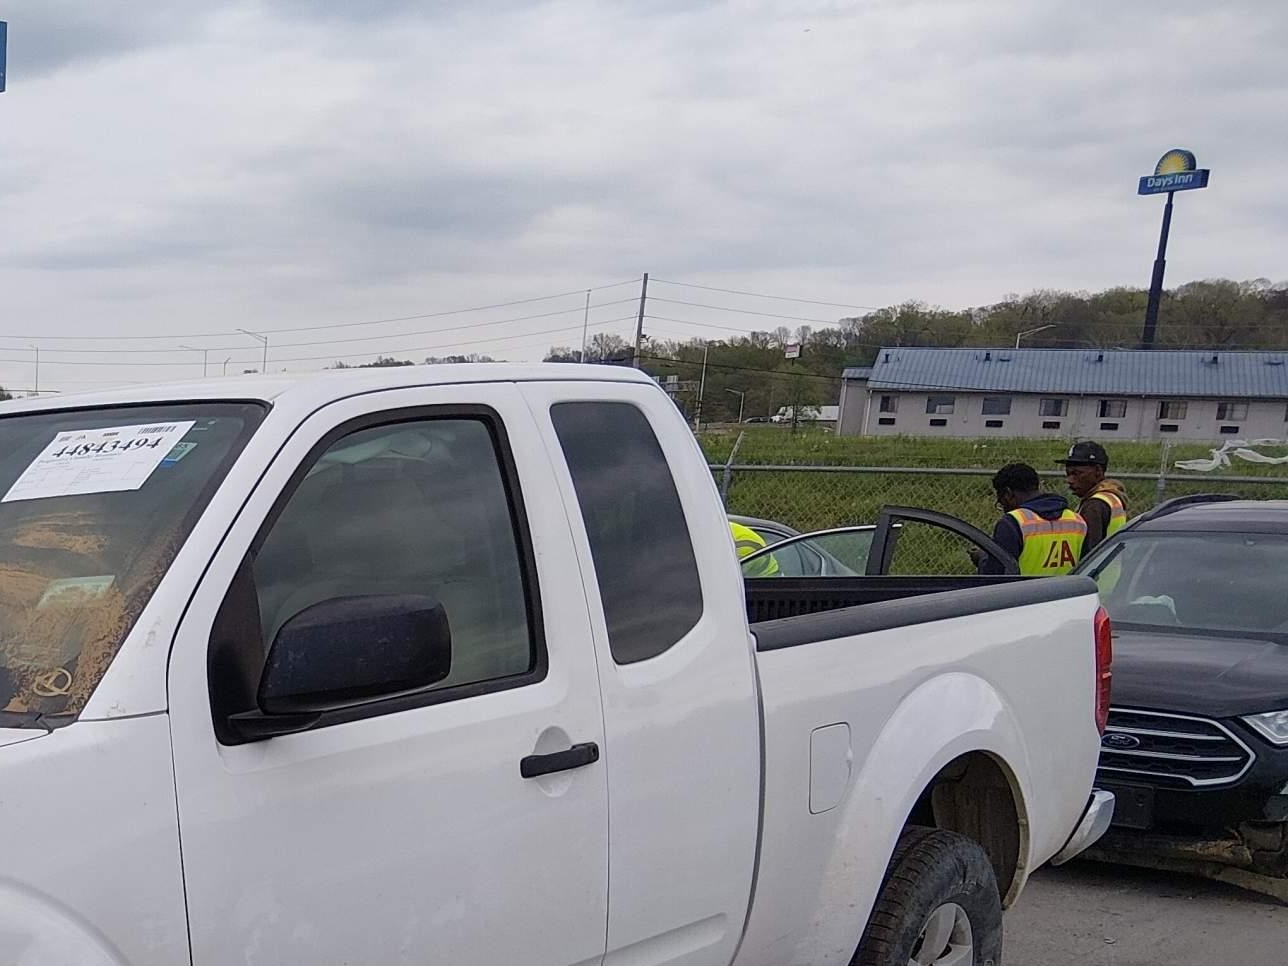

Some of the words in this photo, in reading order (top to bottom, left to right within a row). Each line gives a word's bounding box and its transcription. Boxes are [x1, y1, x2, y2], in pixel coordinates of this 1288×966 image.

[1147, 177, 1173, 188] Days
[1174, 174, 1193, 184] Inn
[52, 436, 162, 457] 44843494
